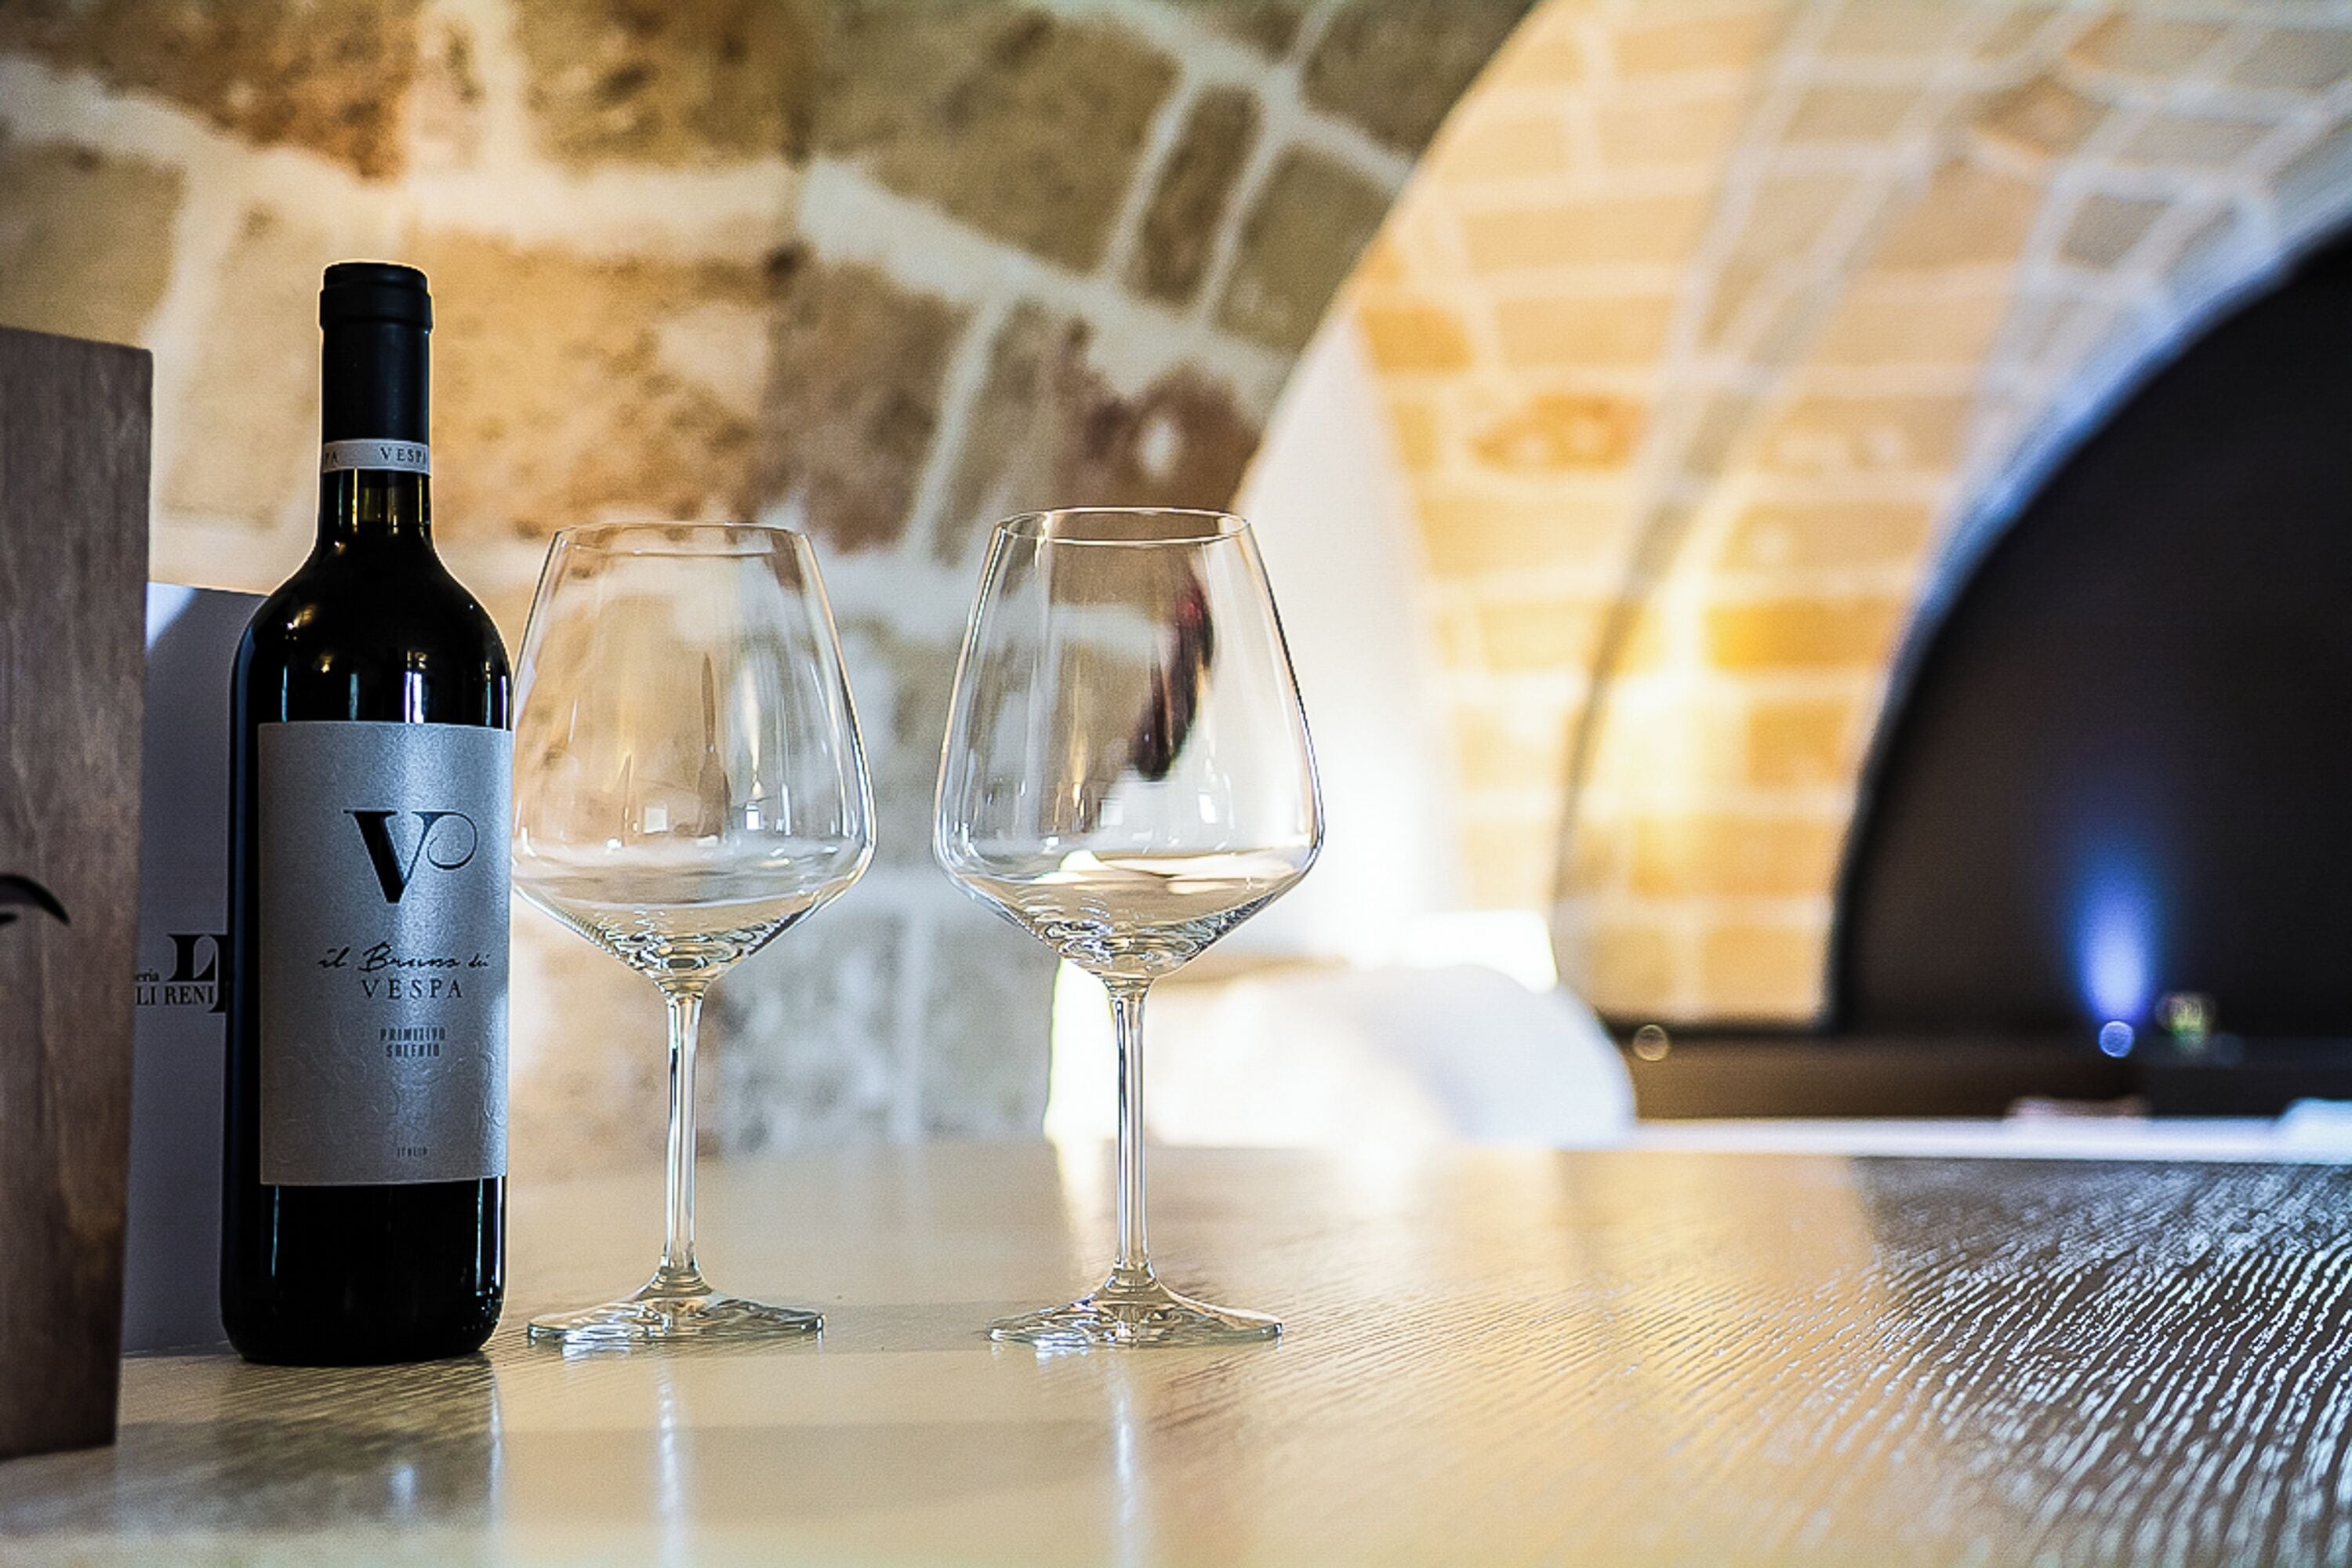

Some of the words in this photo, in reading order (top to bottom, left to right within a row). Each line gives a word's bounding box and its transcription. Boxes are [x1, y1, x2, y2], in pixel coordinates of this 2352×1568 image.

[318, 946, 350, 969] il
[361, 979, 463, 999] VESPA
[379, 1027, 446, 1042] PRIMITIVO
